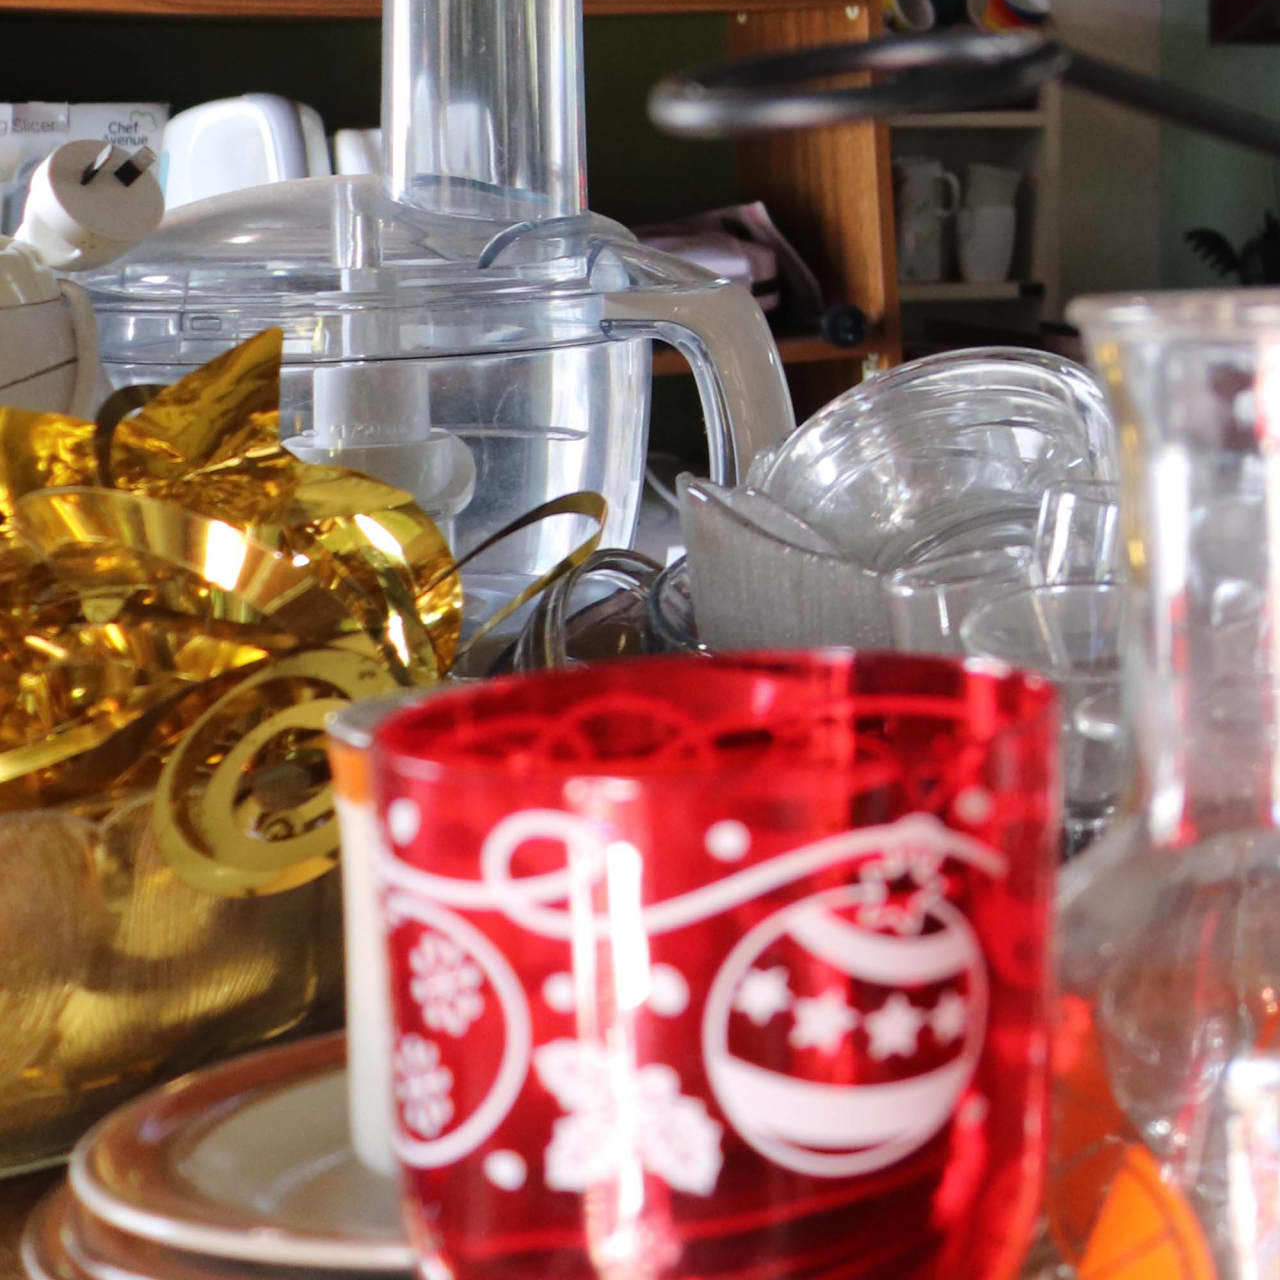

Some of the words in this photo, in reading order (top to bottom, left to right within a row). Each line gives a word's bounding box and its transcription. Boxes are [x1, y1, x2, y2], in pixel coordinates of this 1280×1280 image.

[12, 121, 56, 133] Slicer
[107, 121, 139, 135] Chef
[102, 134, 149, 146] Avenue
